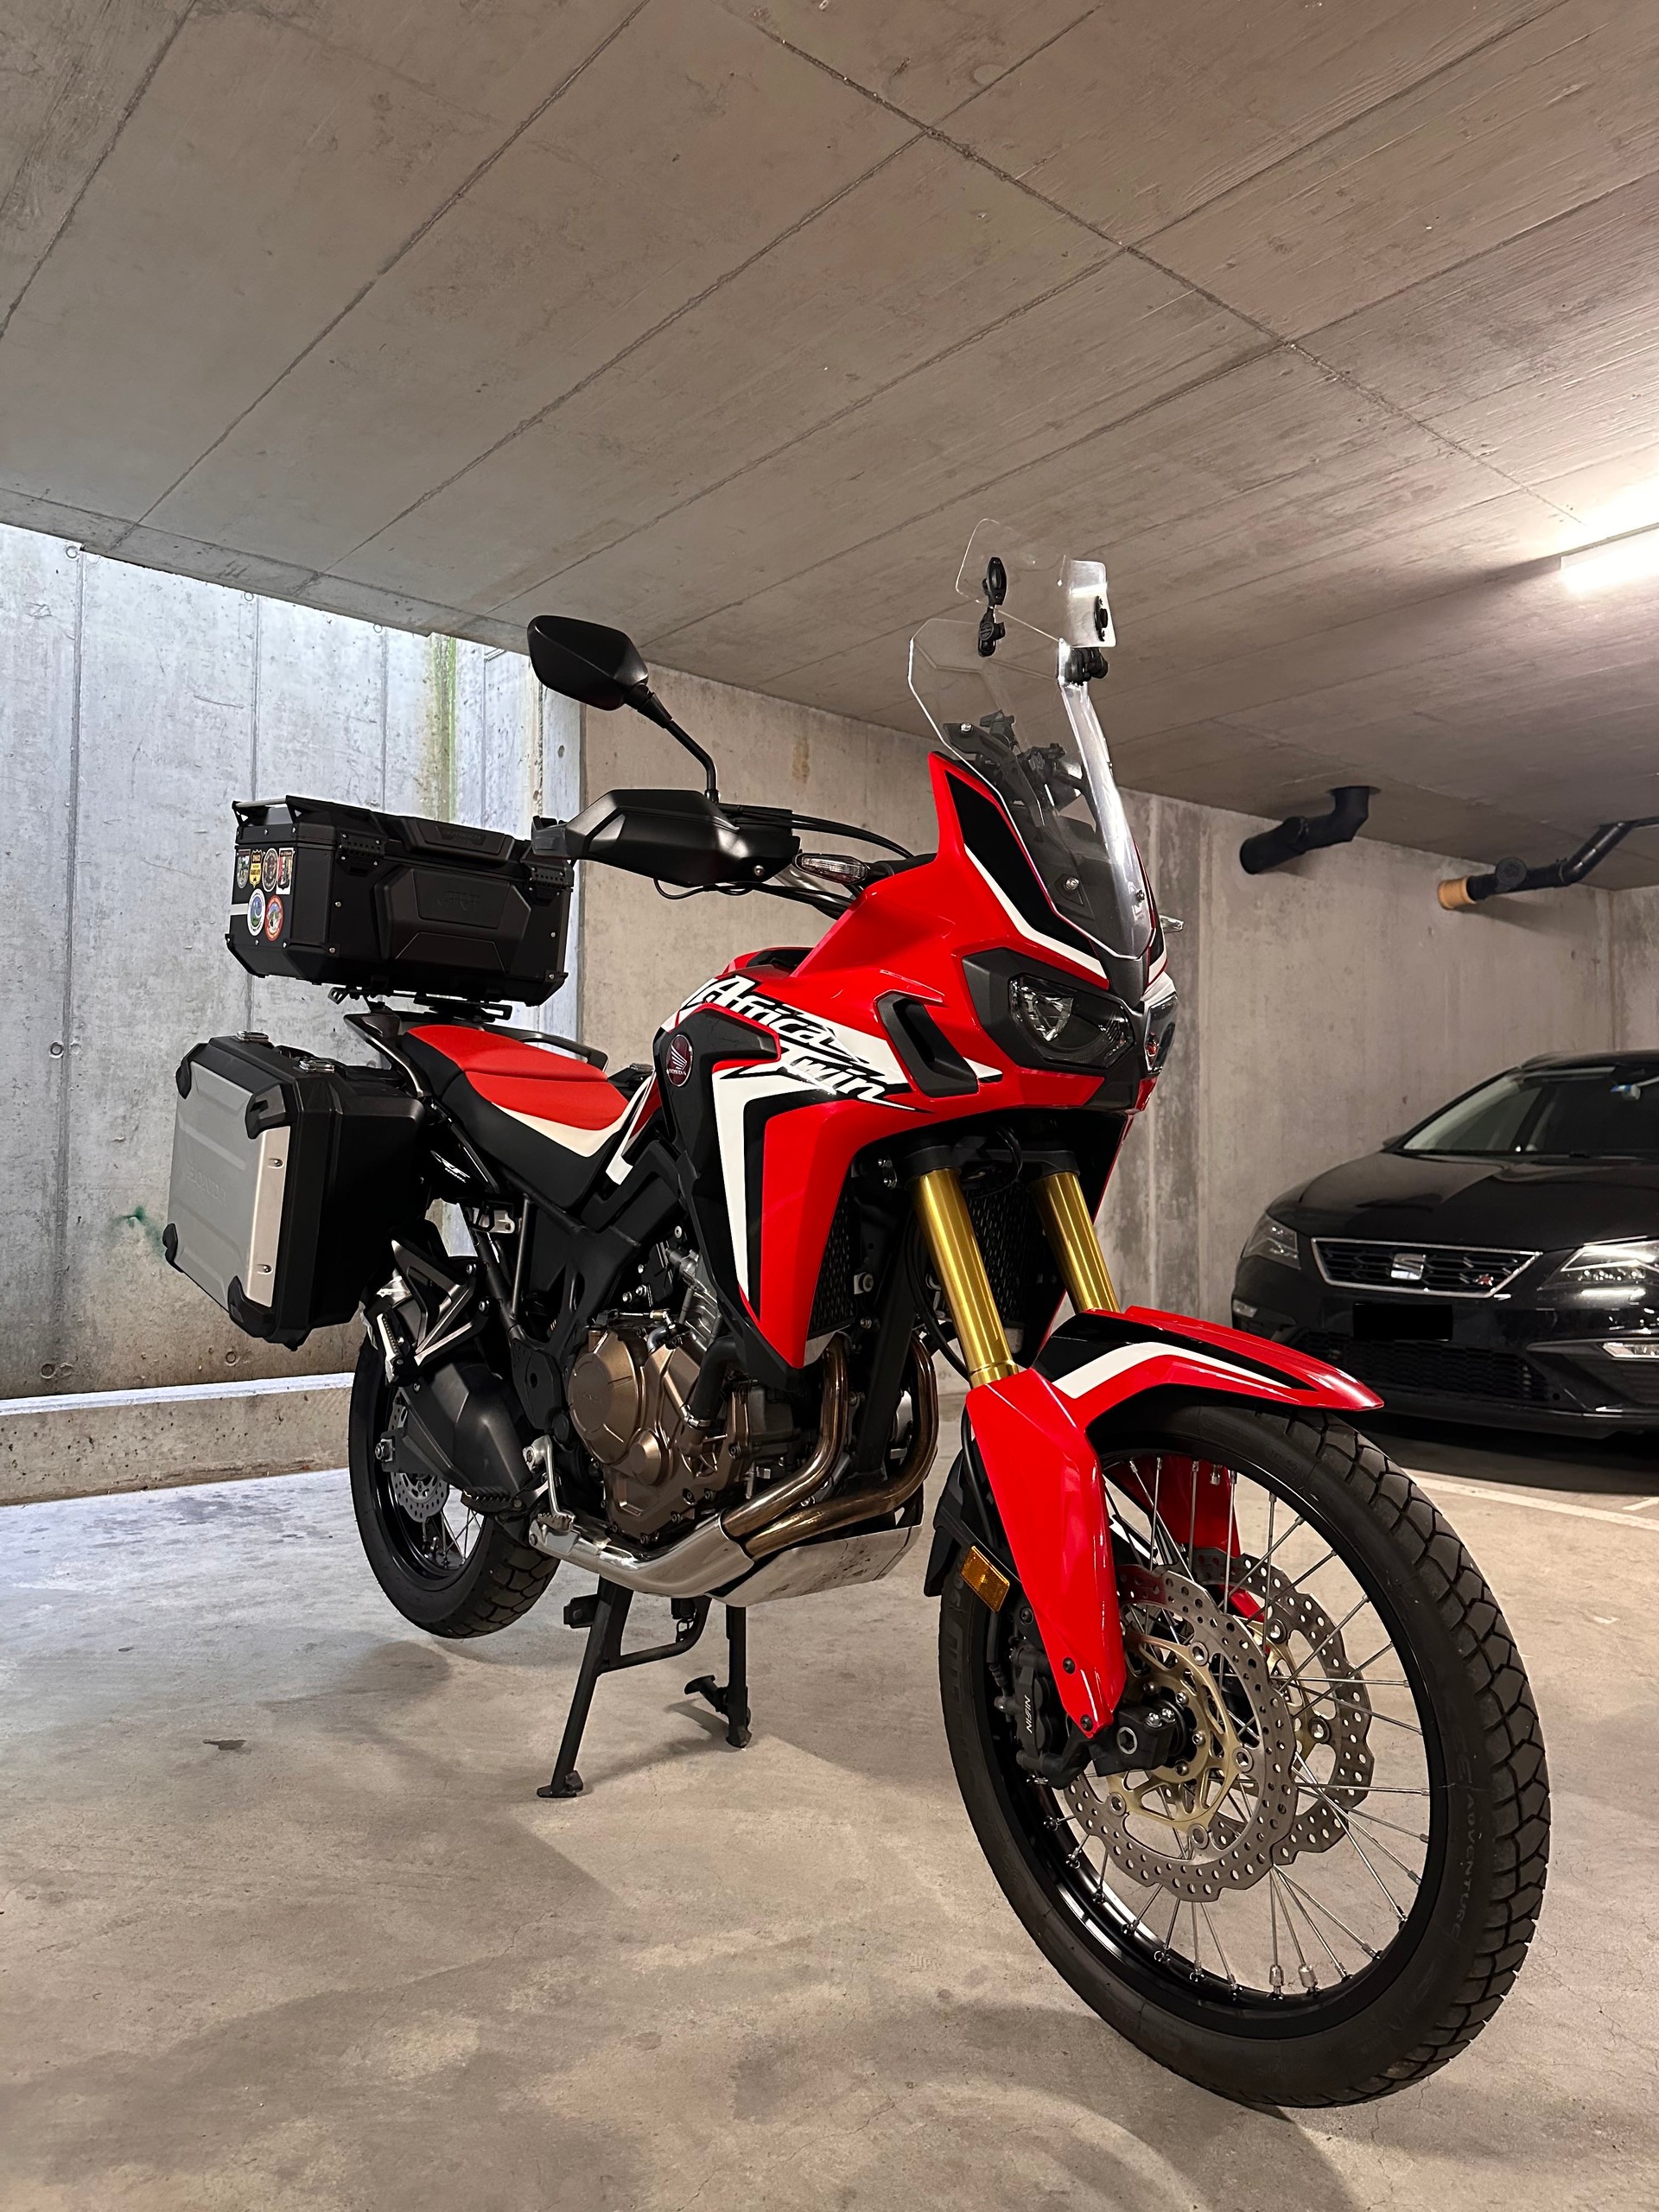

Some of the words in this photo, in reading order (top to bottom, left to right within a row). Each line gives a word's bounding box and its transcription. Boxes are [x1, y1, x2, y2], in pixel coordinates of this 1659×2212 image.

[704, 975, 840, 1054] Africa
[778, 1043, 909, 1109] Twin
[1452, 1794, 1477, 1938] ADVENTURE
